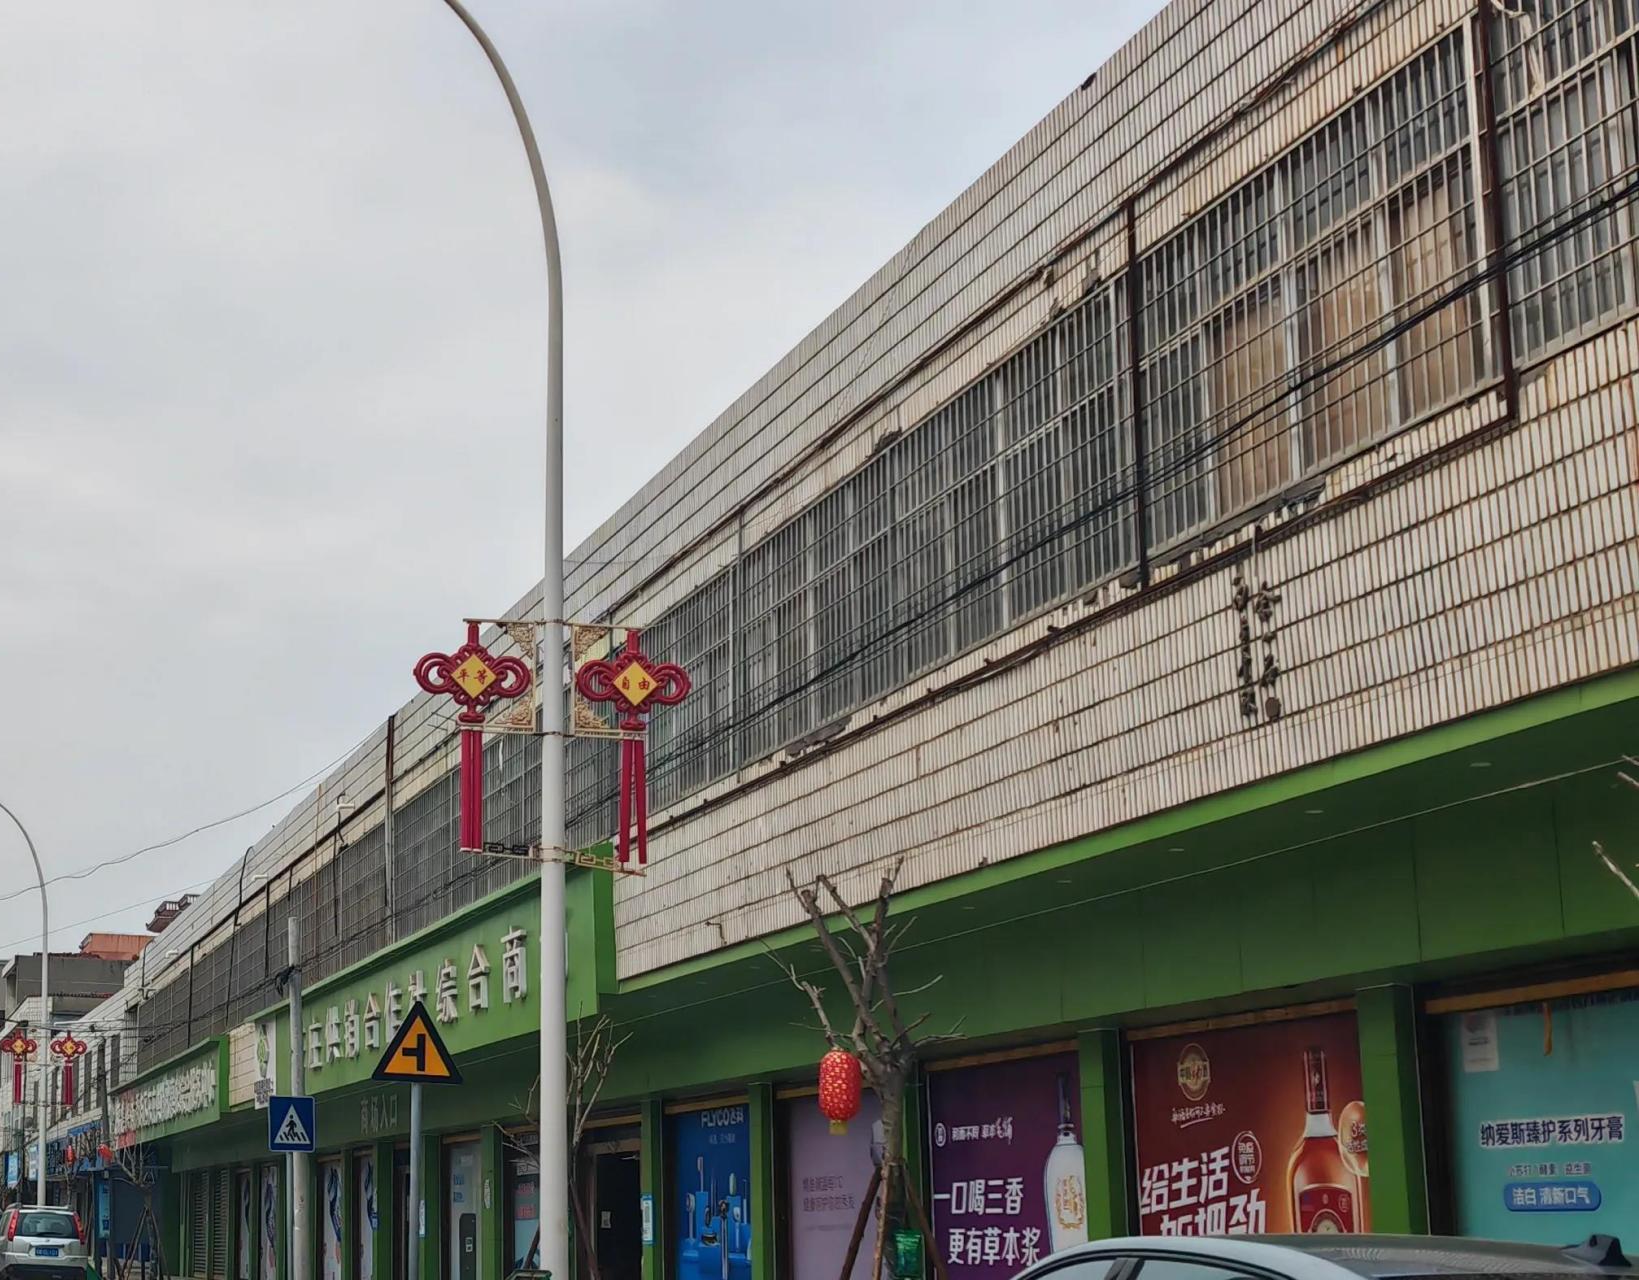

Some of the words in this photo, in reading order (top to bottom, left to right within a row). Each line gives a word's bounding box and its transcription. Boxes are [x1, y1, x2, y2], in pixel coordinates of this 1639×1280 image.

[458, 669, 488, 686] 平等
[621, 675, 651, 692] 自由
[360, 1094, 398, 1134] 商场入口
[1480, 1116, 1623, 1147] 纳爱斯臻护系列牙膏
[934, 1177, 1024, 1215] 一口喝三香
[1140, 1146, 1230, 1215] 给生活
[1512, 1187, 1536, 1205] 洁白
[1539, 1186, 1590, 1205] 清新口气
[947, 1227, 1041, 1266] 更有草本浆
